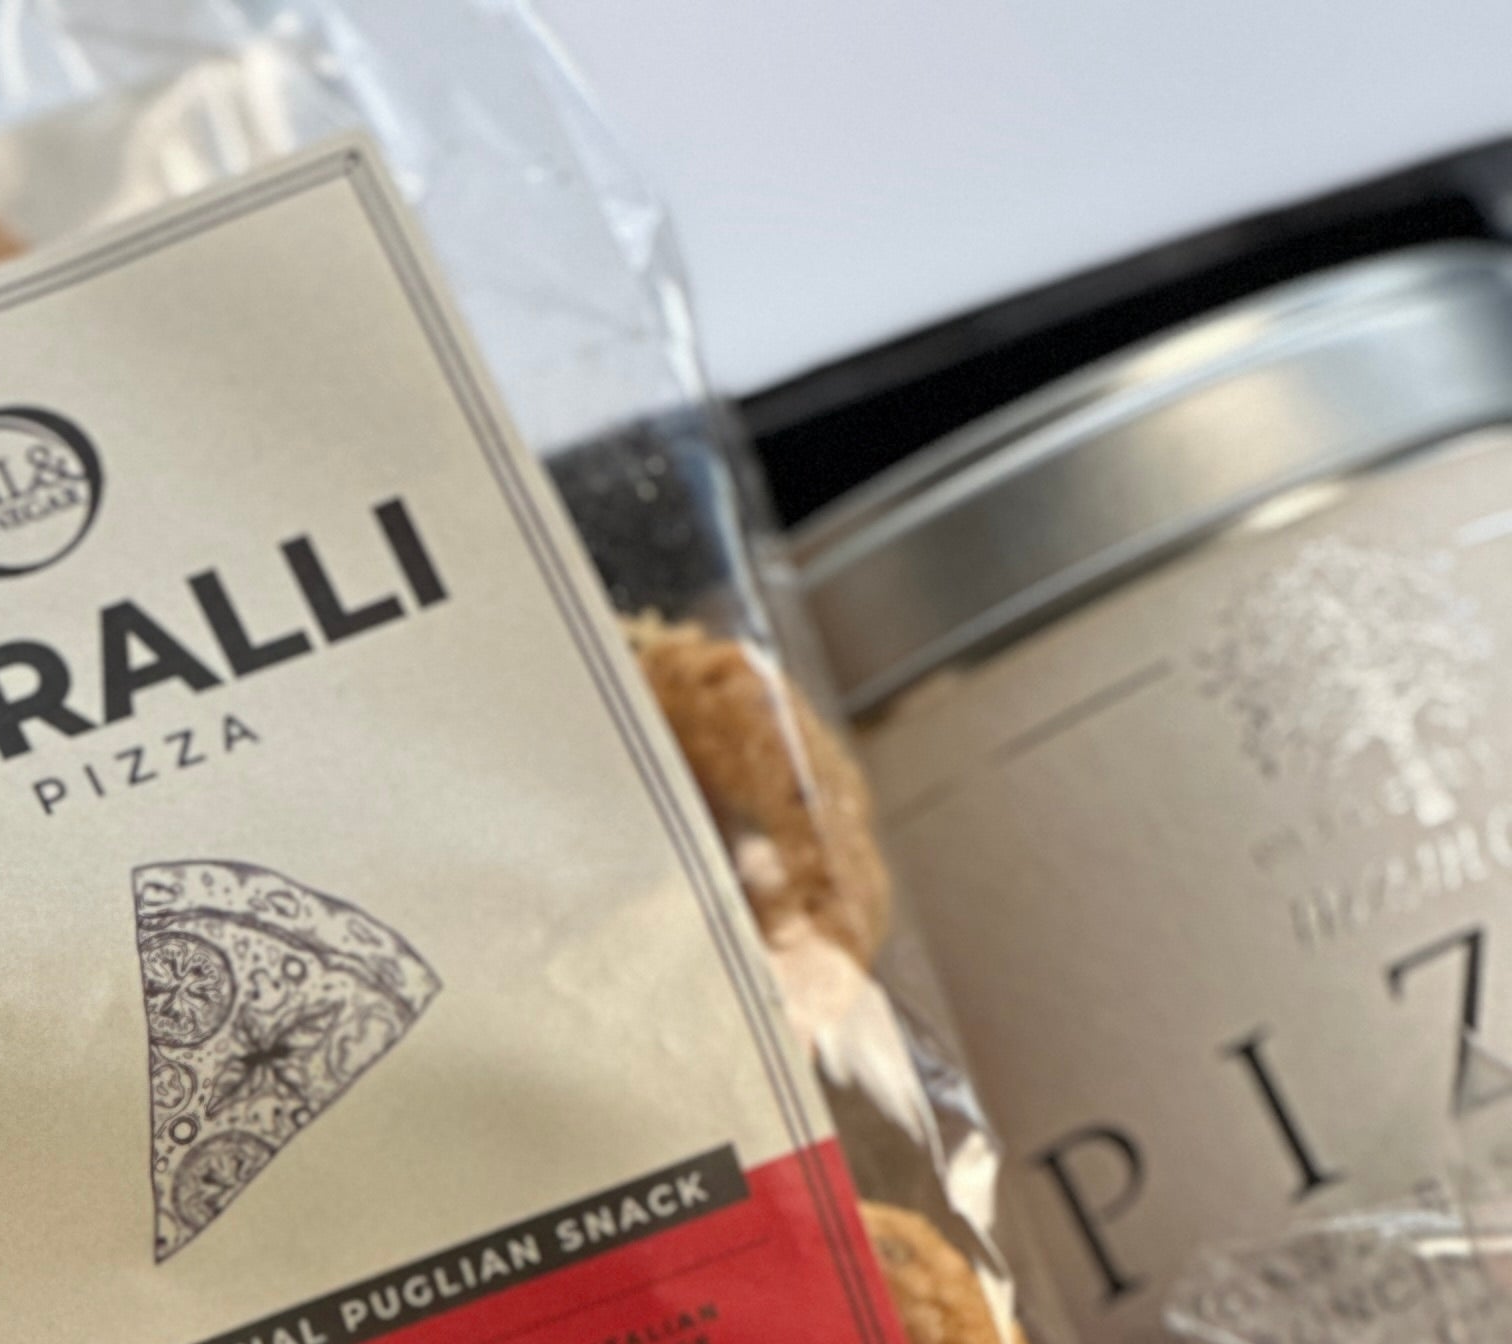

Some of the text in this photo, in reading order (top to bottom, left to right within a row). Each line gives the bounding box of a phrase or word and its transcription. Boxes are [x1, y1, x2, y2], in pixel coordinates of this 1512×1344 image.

[32, 714, 260, 816] PIZZA
[340, 1234, 543, 1333] PUGLIAN
[556, 1171, 711, 1254] SNACK
